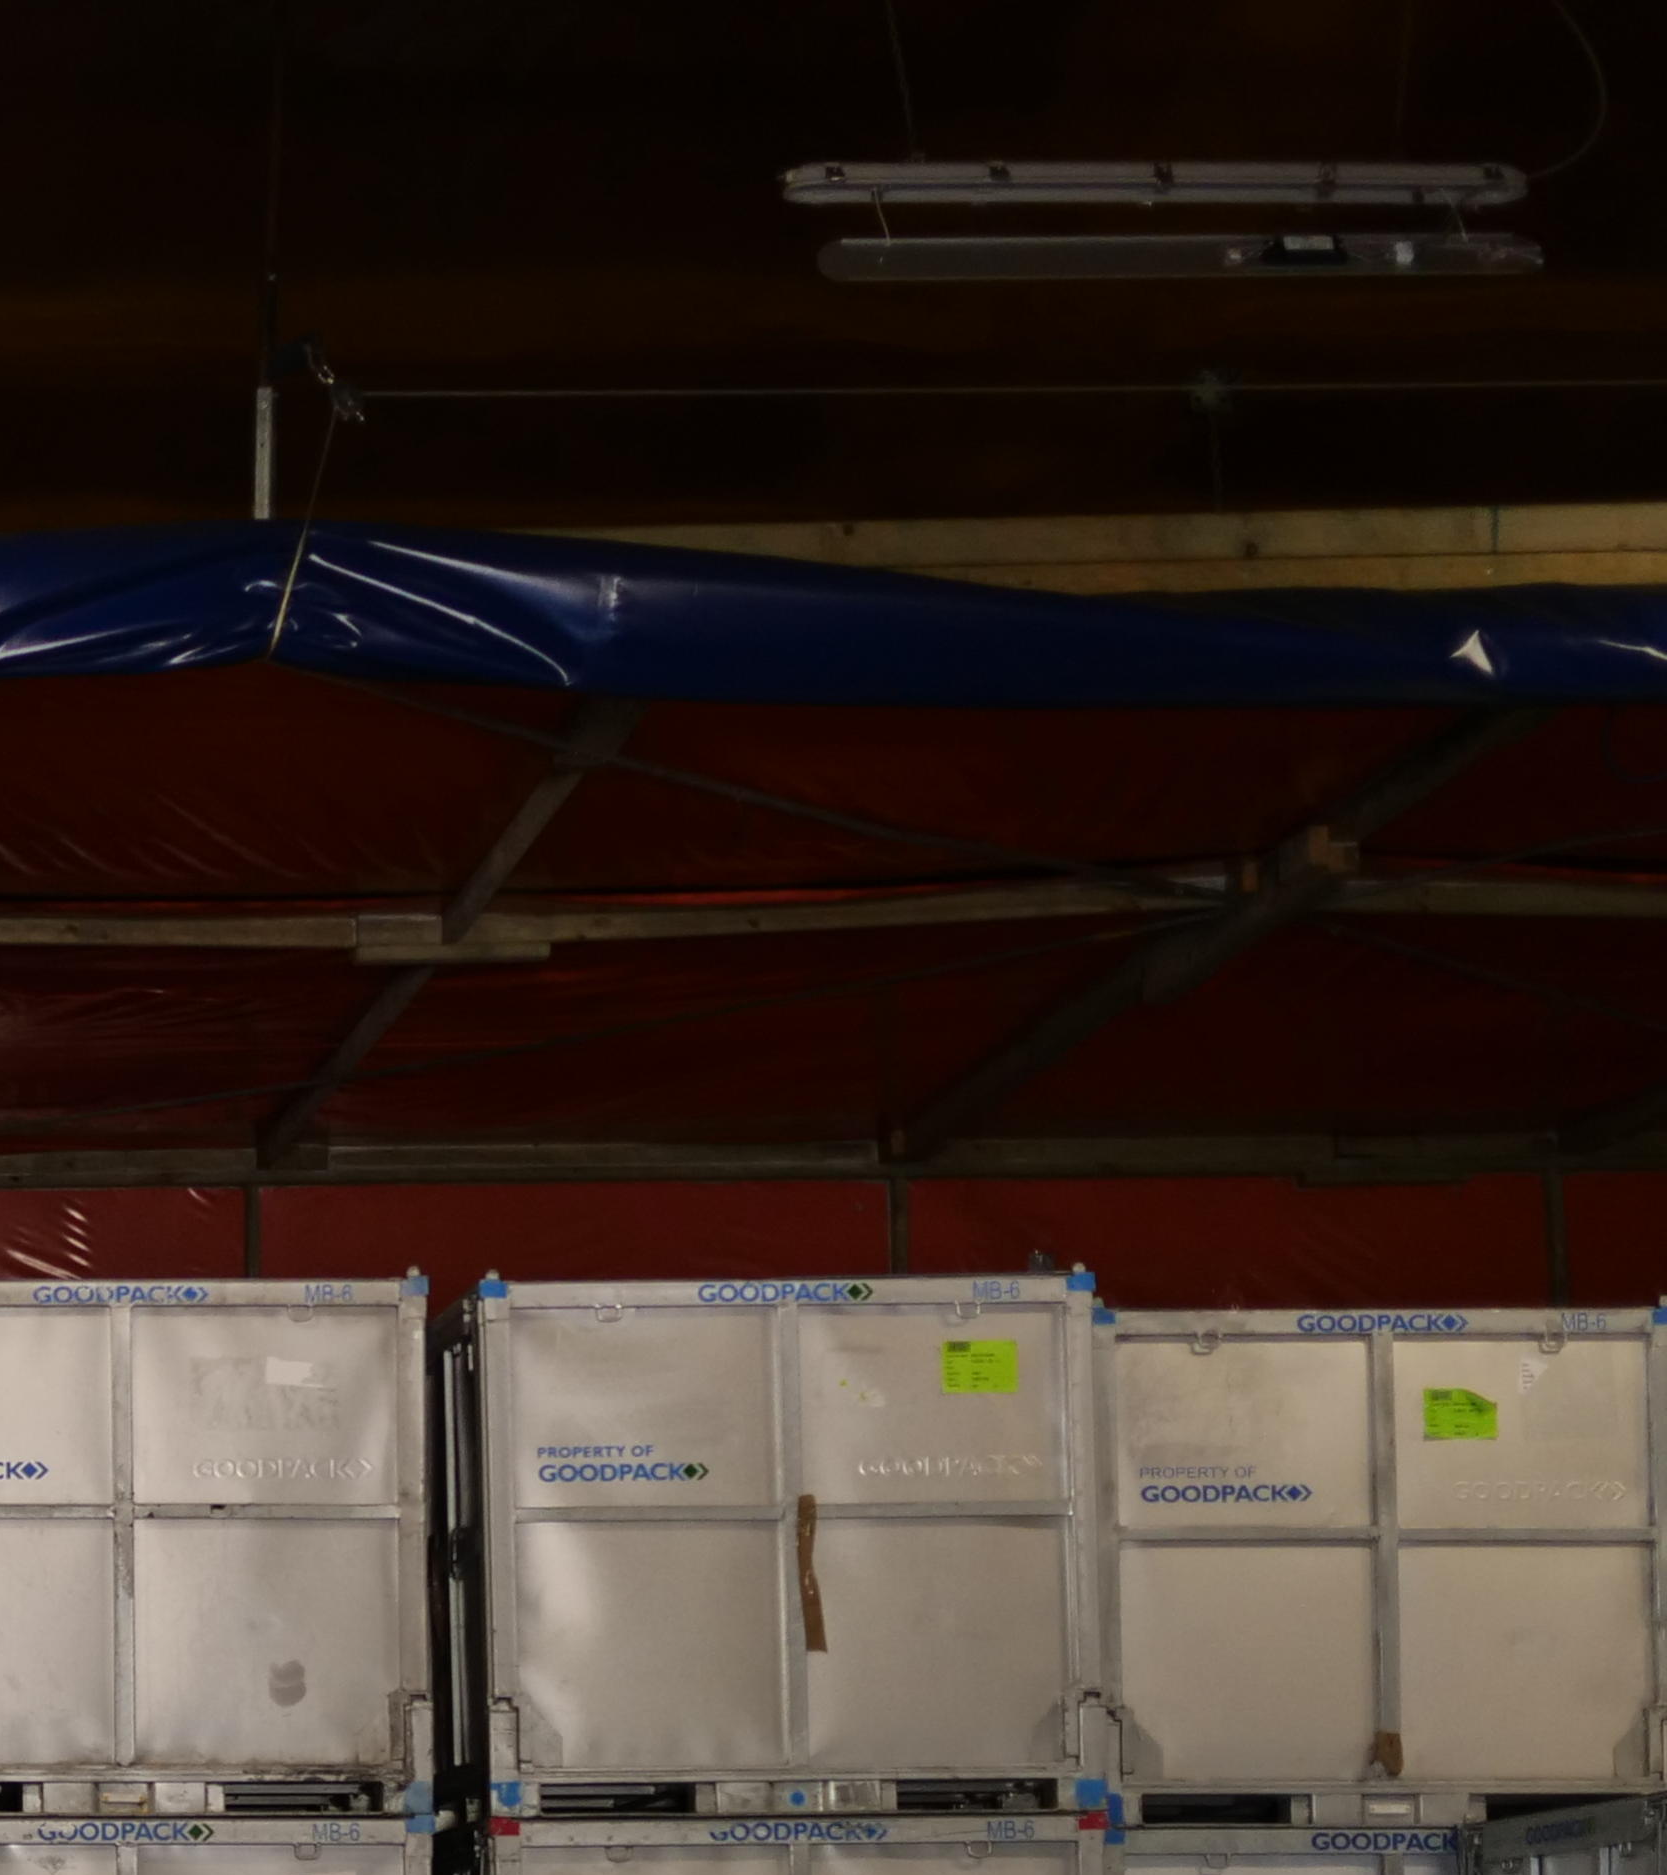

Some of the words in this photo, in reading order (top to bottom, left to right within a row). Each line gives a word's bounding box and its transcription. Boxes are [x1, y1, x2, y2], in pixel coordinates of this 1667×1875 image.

[33, 1285, 185, 1304] GOODPACK
[304, 1285, 353, 1303] MB-6
[698, 1283, 850, 1302] GOODPACK
[972, 1281, 1020, 1300] MB-6
[1297, 1314, 1444, 1332] GOODPACK
[1562, 1313, 1607, 1331] MB-6
[537, 1445, 625, 1458] PROPERTY
[631, 1445, 654, 1457] OF
[538, 1463, 686, 1483] GOODPACK
[1139, 1466, 1229, 1479] PROPERTY
[1234, 1466, 1257, 1478] OF
[1140, 1484, 1287, 1503] GOODPACK
[312, 1822, 360, 1841] MB-6
[987, 1820, 1035, 1840] MB-6
[1312, 1832, 1456, 1851] GOODPACK
